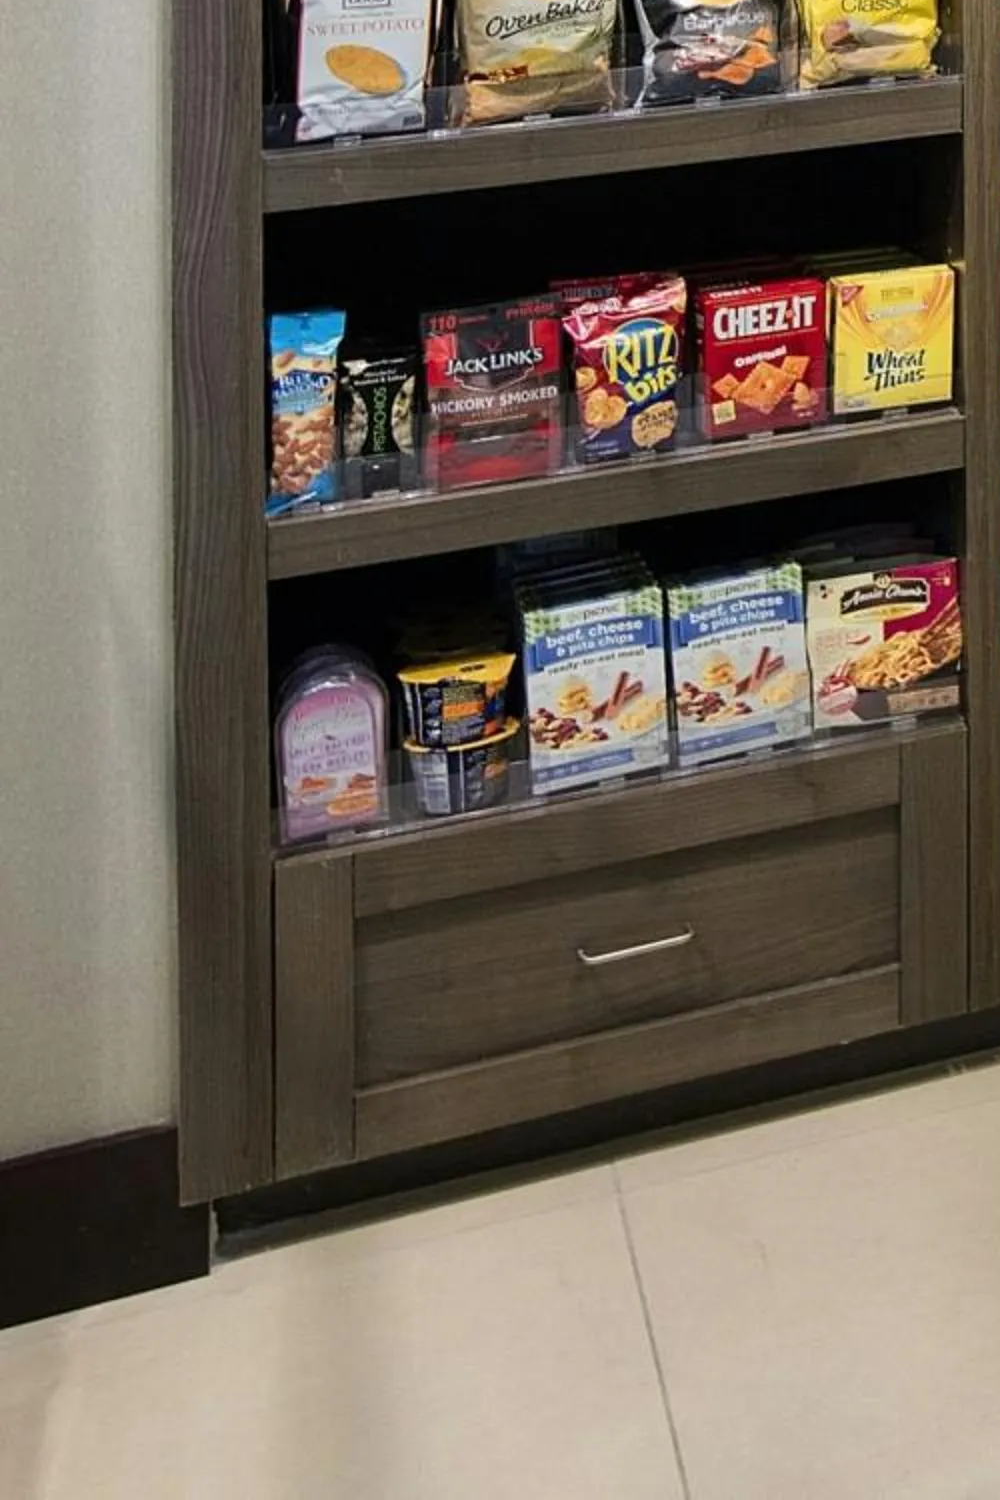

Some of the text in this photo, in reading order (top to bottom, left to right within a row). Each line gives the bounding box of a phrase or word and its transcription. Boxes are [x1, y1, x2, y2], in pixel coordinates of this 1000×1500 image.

[485, 12, 544, 37] Oven
[445, 357, 489, 375] JACK
[606, 325, 675, 383] RITZ
[867, 347, 925, 374] Wheat
[624, 365, 678, 402] bits
[864, 368, 925, 392] Thins
[432, 386, 558, 414] HICKORY SMOKED
[730, 596, 785, 612] cheese
[588, 619, 643, 637] cheese
[598, 632, 634, 648] chips
